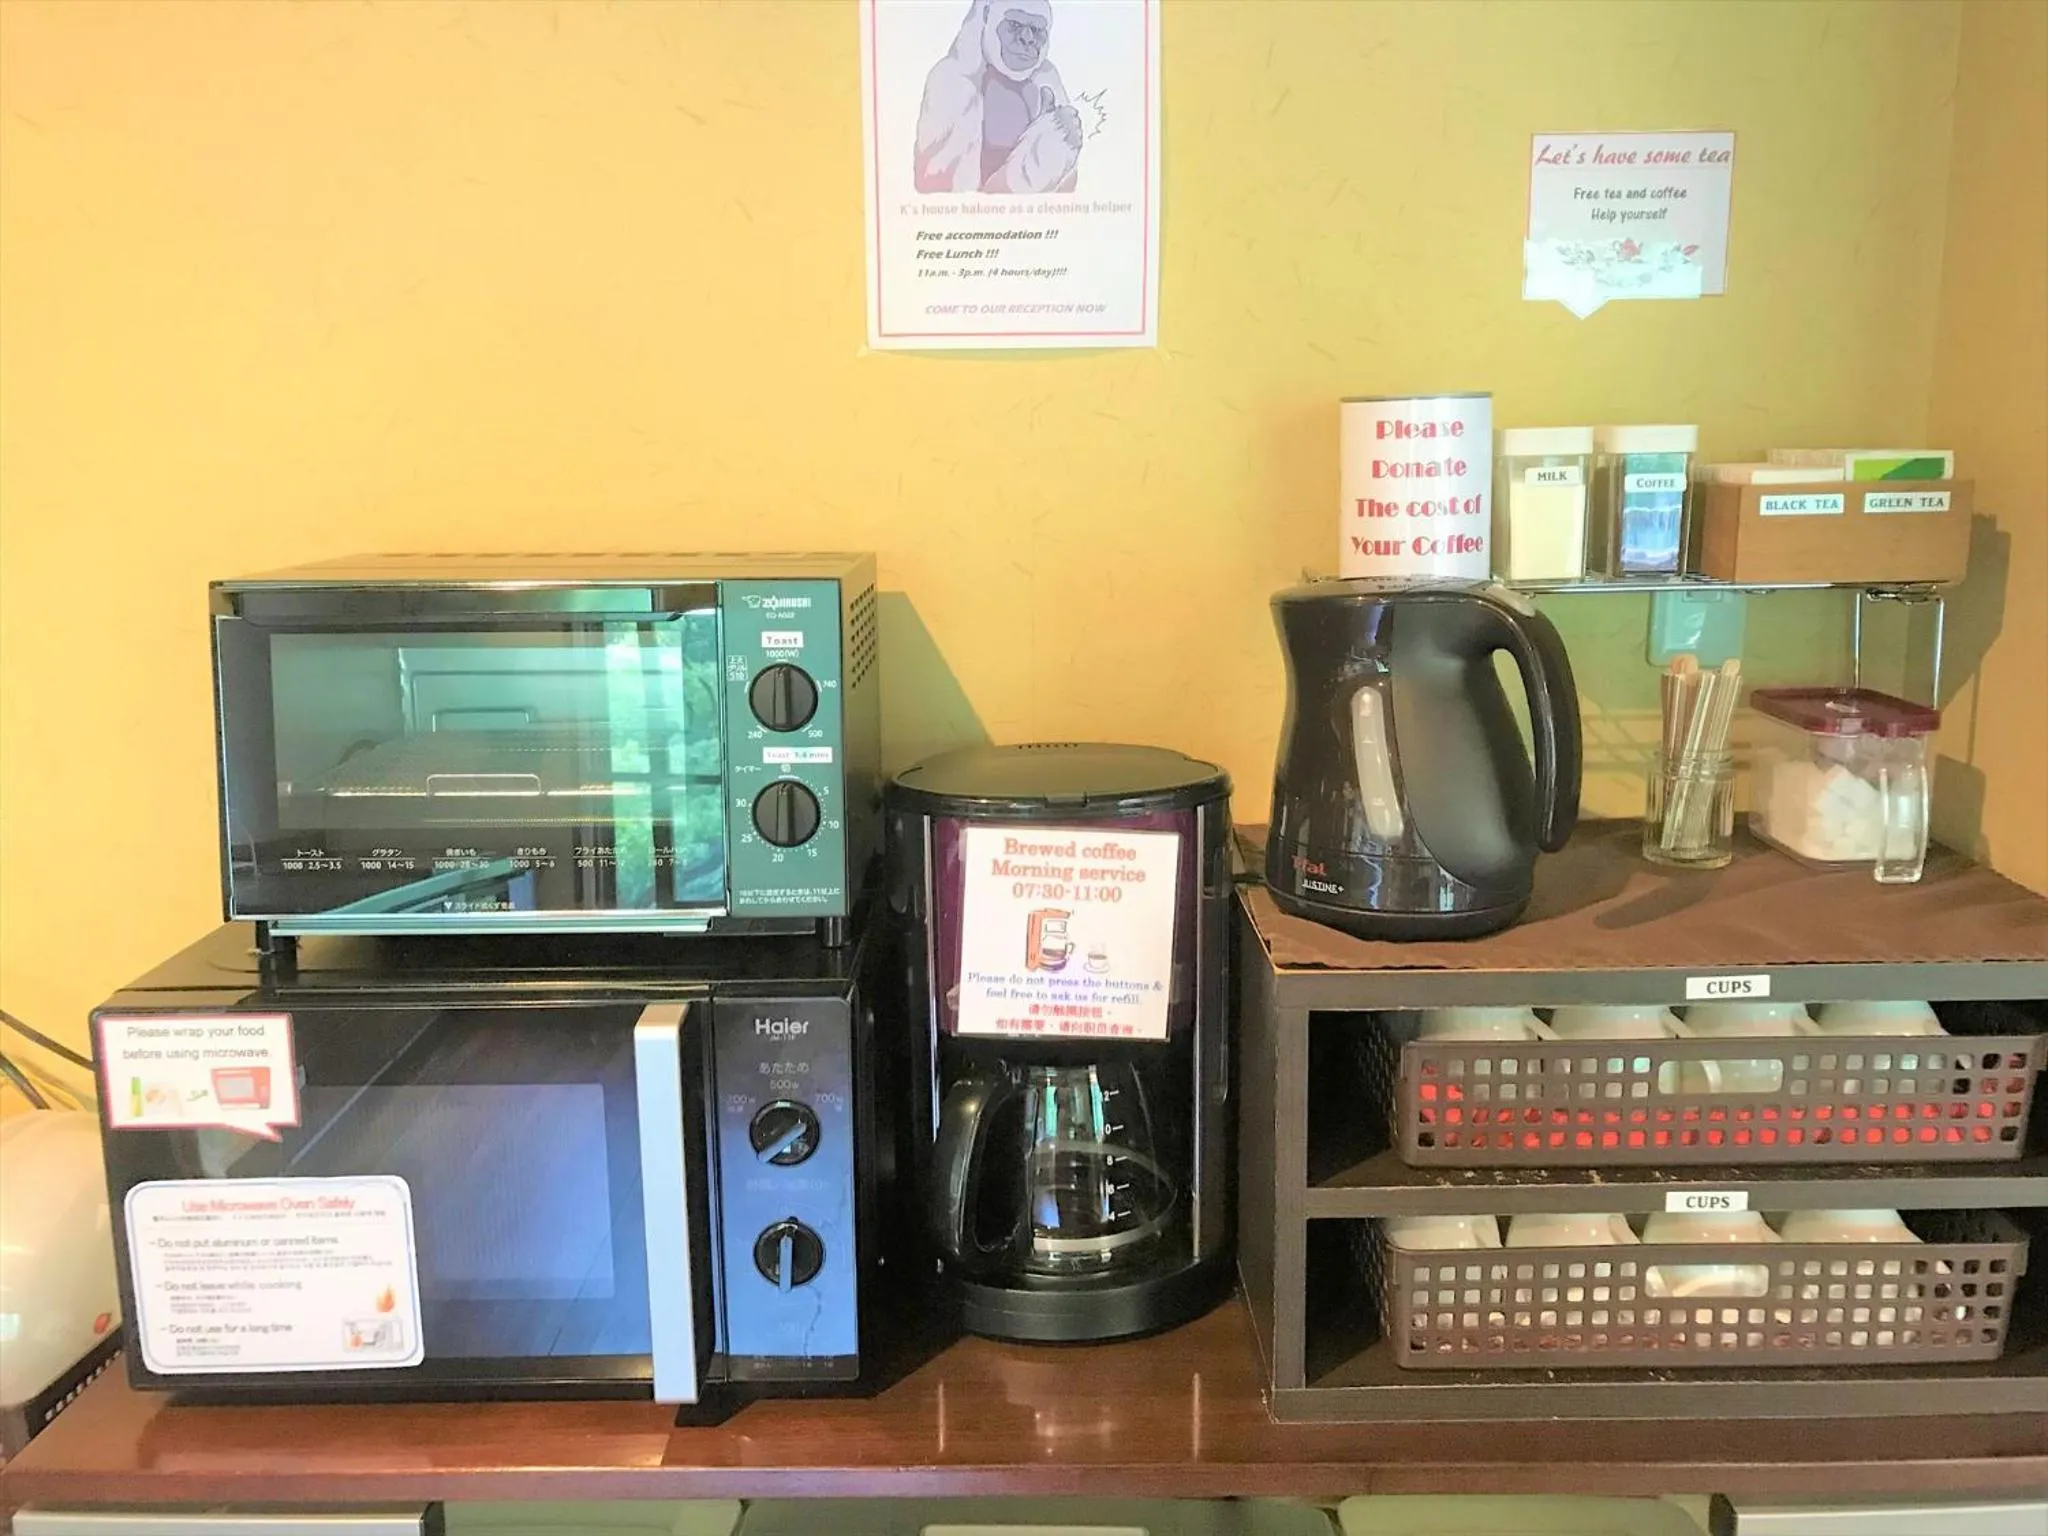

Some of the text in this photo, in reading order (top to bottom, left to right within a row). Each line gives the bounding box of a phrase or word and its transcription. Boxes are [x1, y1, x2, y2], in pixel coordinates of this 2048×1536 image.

[1534, 143, 1731, 166] Let's have some tea
[1573, 186, 1687, 199] Free tea and coffee
[900, 200, 1132, 216] K's house hakone as a cleaning helper
[1591, 207, 1668, 223] Help yourself
[916, 229, 1059, 240] Free accommodation !!!
[916, 248, 1000, 259] Free Lunch !!!
[918, 268, 950, 278] 11a.m.
[959, 267, 986, 279] 3p.m.
[925, 302, 1107, 315] COME TO OUR RECEPTION NOW
[1376, 419, 1464, 440] Please
[1372, 457, 1467, 479] Donate
[1537, 470, 1568, 482] MILK
[1355, 493, 1482, 518] The cost of
[1766, 498, 1840, 511] BLACK TEA
[1869, 496, 1945, 510] GREEN TEA
[1351, 534, 1484, 556] Your Coffee
[766, 636, 798, 646] Toast
[823, 680, 838, 689] 740
[747, 731, 763, 739] 240
[808, 730, 823, 738] 500
[823, 786, 829, 795] 5
[736, 799, 747, 808] 30
[828, 821, 839, 829] 10
[741, 834, 752, 843] 25
[297, 849, 324, 857] トースト
[372, 848, 401, 857] グラタン
[808, 849, 818, 857] 15
[1004, 837, 1137, 861] Brewed coffee
[509, 860, 530, 868] 1000
[577, 859, 593, 867] 500
[772, 854, 784, 862] 20
[283, 862, 303, 870] 1000
[362, 861, 382, 869] 1000
[992, 859, 1147, 883] Morning service
[1012, 882, 1122, 903] 07:30-11:00
[967, 972, 1163, 991] Please do not press the buttons &
[1706, 980, 1752, 994] CUPS
[986, 988, 1006, 999] feel
[1010, 988, 1033, 999] free
[1036, 990, 1048, 1000] to
[1051, 991, 1069, 1001] ask
[1075, 994, 1088, 1002] us
[1091, 992, 1108, 1003] for
[127, 1025, 265, 1039] Please wrap your food
[755, 1017, 809, 1035] Haier
[122, 1048, 162, 1059] before
[166, 1048, 199, 1061] using
[759, 1062, 810, 1074] あたため
[1107, 1155, 1113, 1166] 8
[182, 1199, 208, 1212] Use
[210, 1197, 278, 1211] Microwave
[280, 1196, 315, 1210] Oven
[1686, 1195, 1731, 1209] CUPS
[1109, 1211, 1115, 1221] 4
[158, 1237, 173, 1248] Do
[174, 1238, 190, 1248] not
[193, 1238, 209, 1249] put
[212, 1236, 257, 1247] aluminum
[260, 1239, 271, 1247] or
[273, 1235, 309, 1247] canned
[164, 1280, 302, 1291] Do not leave while cooking
[169, 1322, 293, 1335] Do not use for a long time
